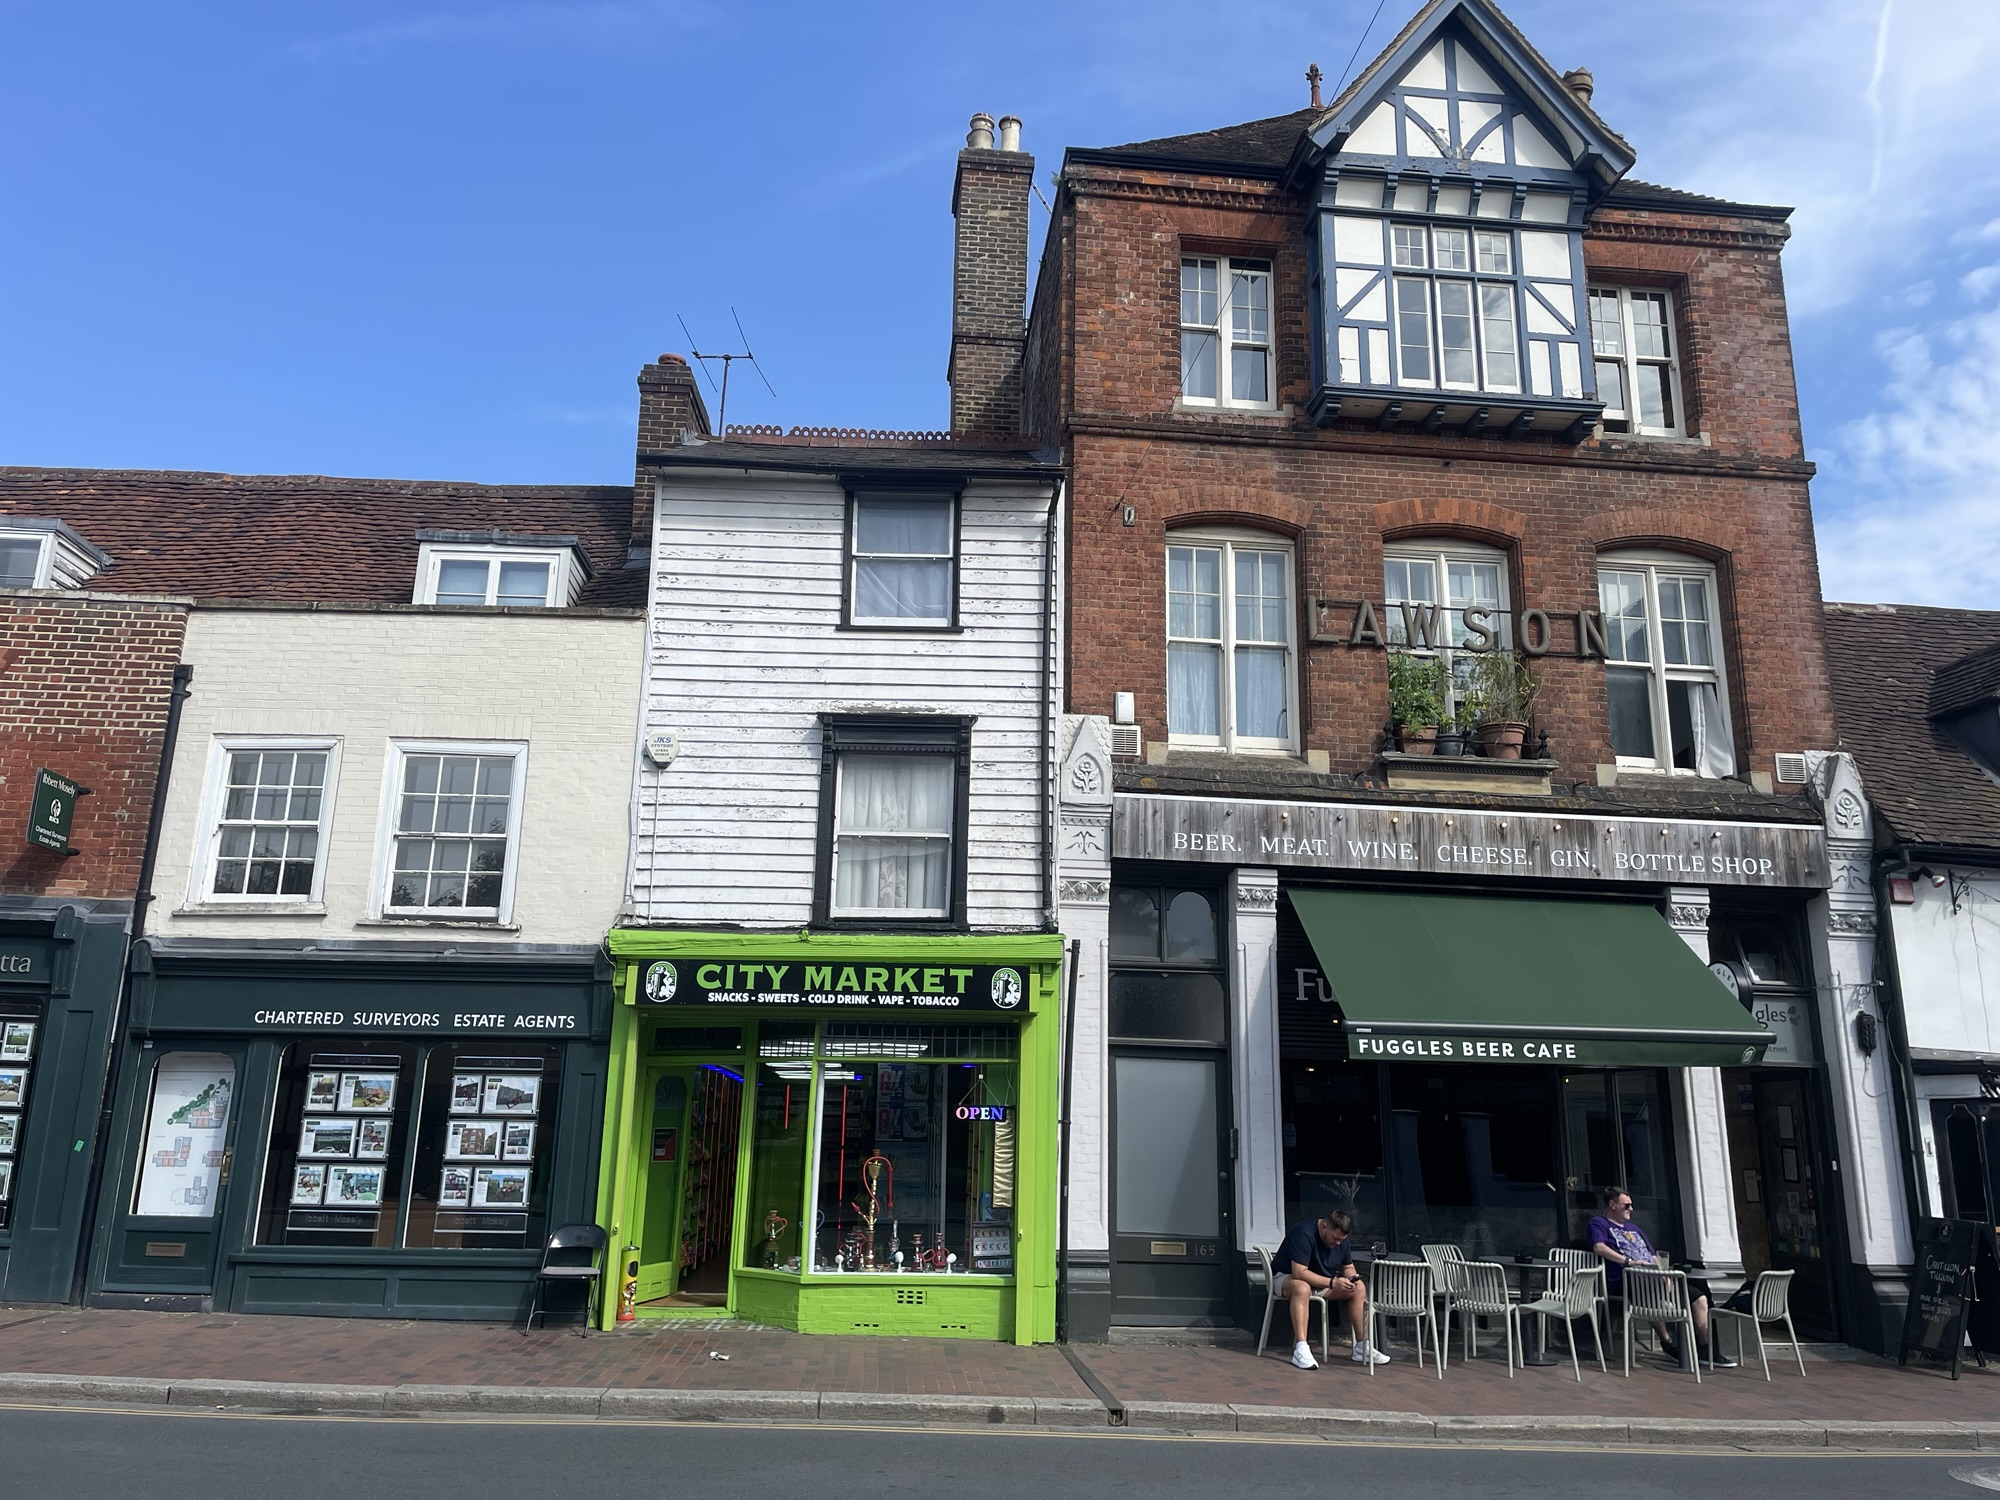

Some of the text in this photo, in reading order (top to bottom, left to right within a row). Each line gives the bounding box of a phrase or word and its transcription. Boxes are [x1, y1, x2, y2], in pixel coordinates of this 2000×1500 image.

[1306, 594, 1609, 658] LAWSON
[43, 773, 76, 798] Ibbett Mosely
[49, 815, 59, 824] RICS
[1173, 832, 1775, 876] BEER. MEAT. WINE. CHEESE. GIN. BOTTLE SHOP.
[696, 964, 974, 994] CITY MARKET
[1711, 968, 1735, 988] GLES
[708, 992, 749, 1002] SNACKS
[758, 993, 800, 1004] SWEETS
[808, 994, 835, 1004] COLD
[837, 994, 869, 1004] DRINK
[878, 995, 904, 1005] VAPE
[912, 996, 960, 1006] TOBACCO
[254, 1011, 575, 1029] CHARTERED SURVEYORS ESTATE AGENTS
[1755, 1004, 1786, 1029] gles
[1358, 1038, 1576, 1058] FUGGLES BEER CAFE
[956, 1106, 1004, 1120] OPEN
[1194, 1245, 1216, 1256] 165
